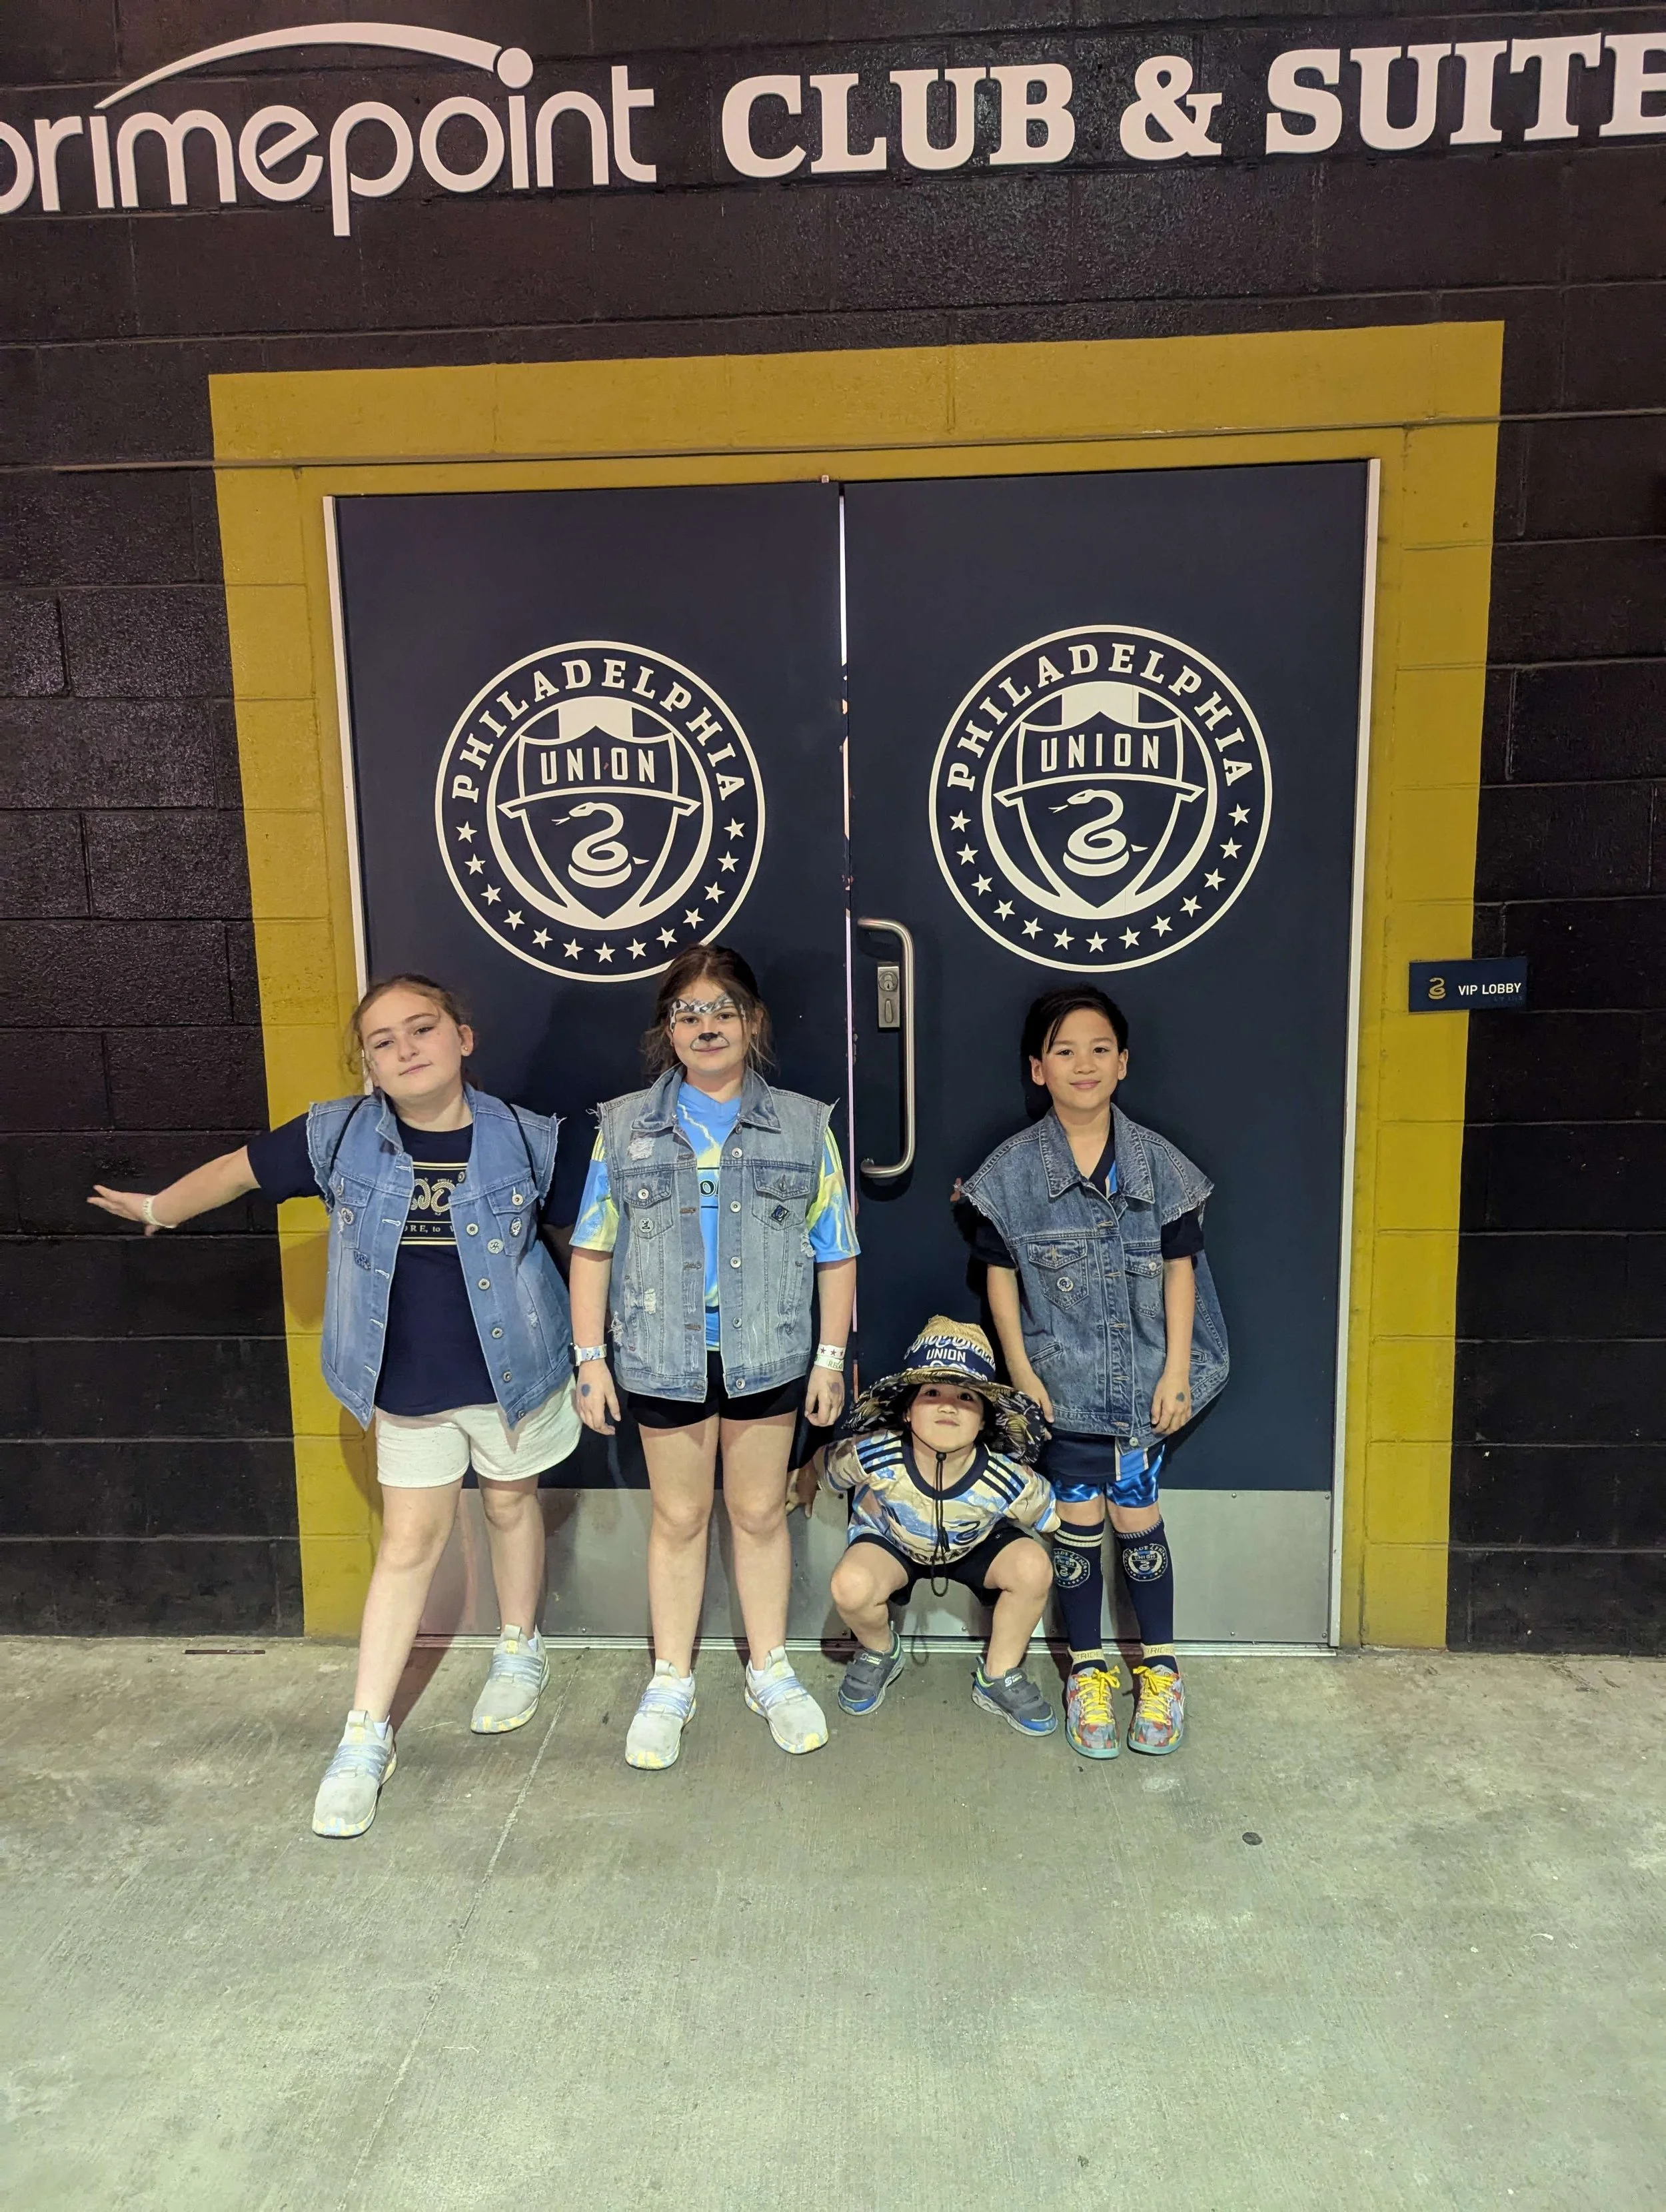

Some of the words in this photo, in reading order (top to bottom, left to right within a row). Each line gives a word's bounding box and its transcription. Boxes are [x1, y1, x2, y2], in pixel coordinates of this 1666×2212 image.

[721, 63, 1076, 178] CLUB
[1120, 55, 1222, 162] &
[1265, 32, 1666, 155] SUITE
[452, 658, 745, 802] PHILADELPHIA
[946, 642, 1253, 792] PHILADELPHIA
[540, 747, 656, 785] UNION
[1041, 733, 1160, 773] UNION
[1458, 985, 1477, 995] VIP
[1481, 983, 1521, 995] LOBBY
[926, 1348, 966, 1363] UNION
